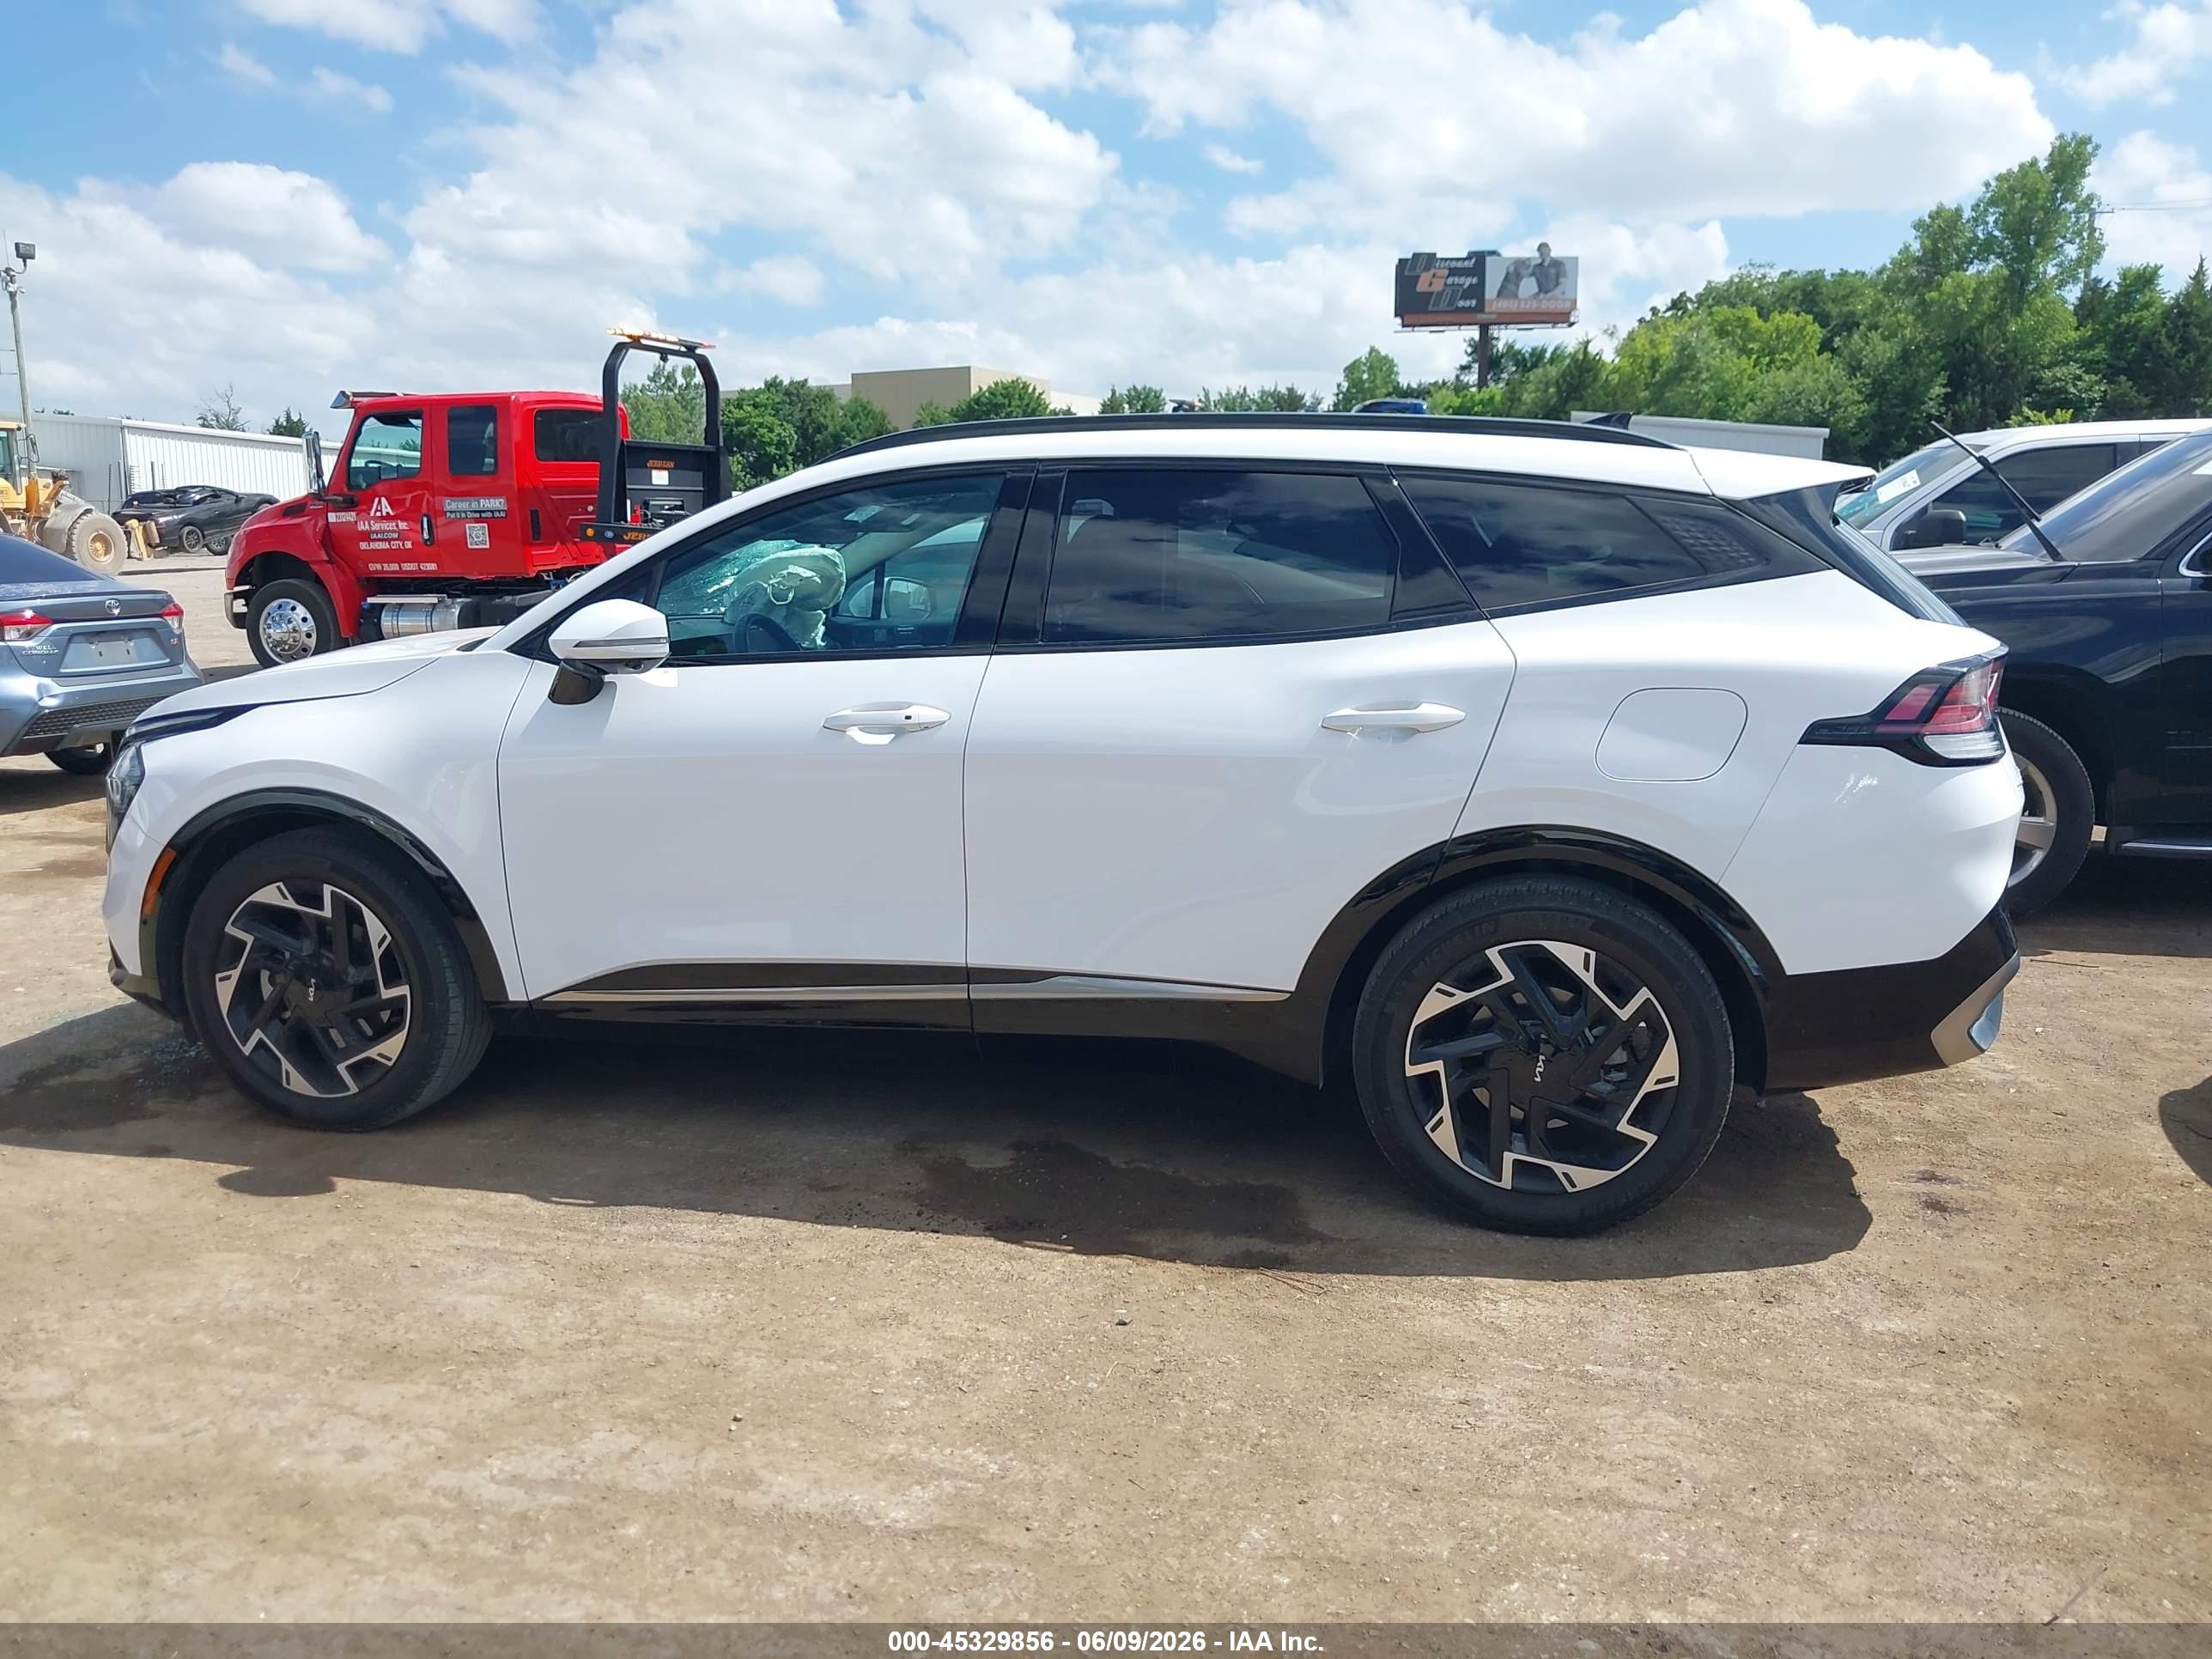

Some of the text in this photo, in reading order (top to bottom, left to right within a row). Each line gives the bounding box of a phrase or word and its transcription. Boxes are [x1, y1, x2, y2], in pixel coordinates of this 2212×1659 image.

[446, 498, 505, 509] Career in PARK?
[357, 520, 410, 532] IAA Services, Inc.
[359, 540, 412, 550] OKLAHOMA CITY, OK
